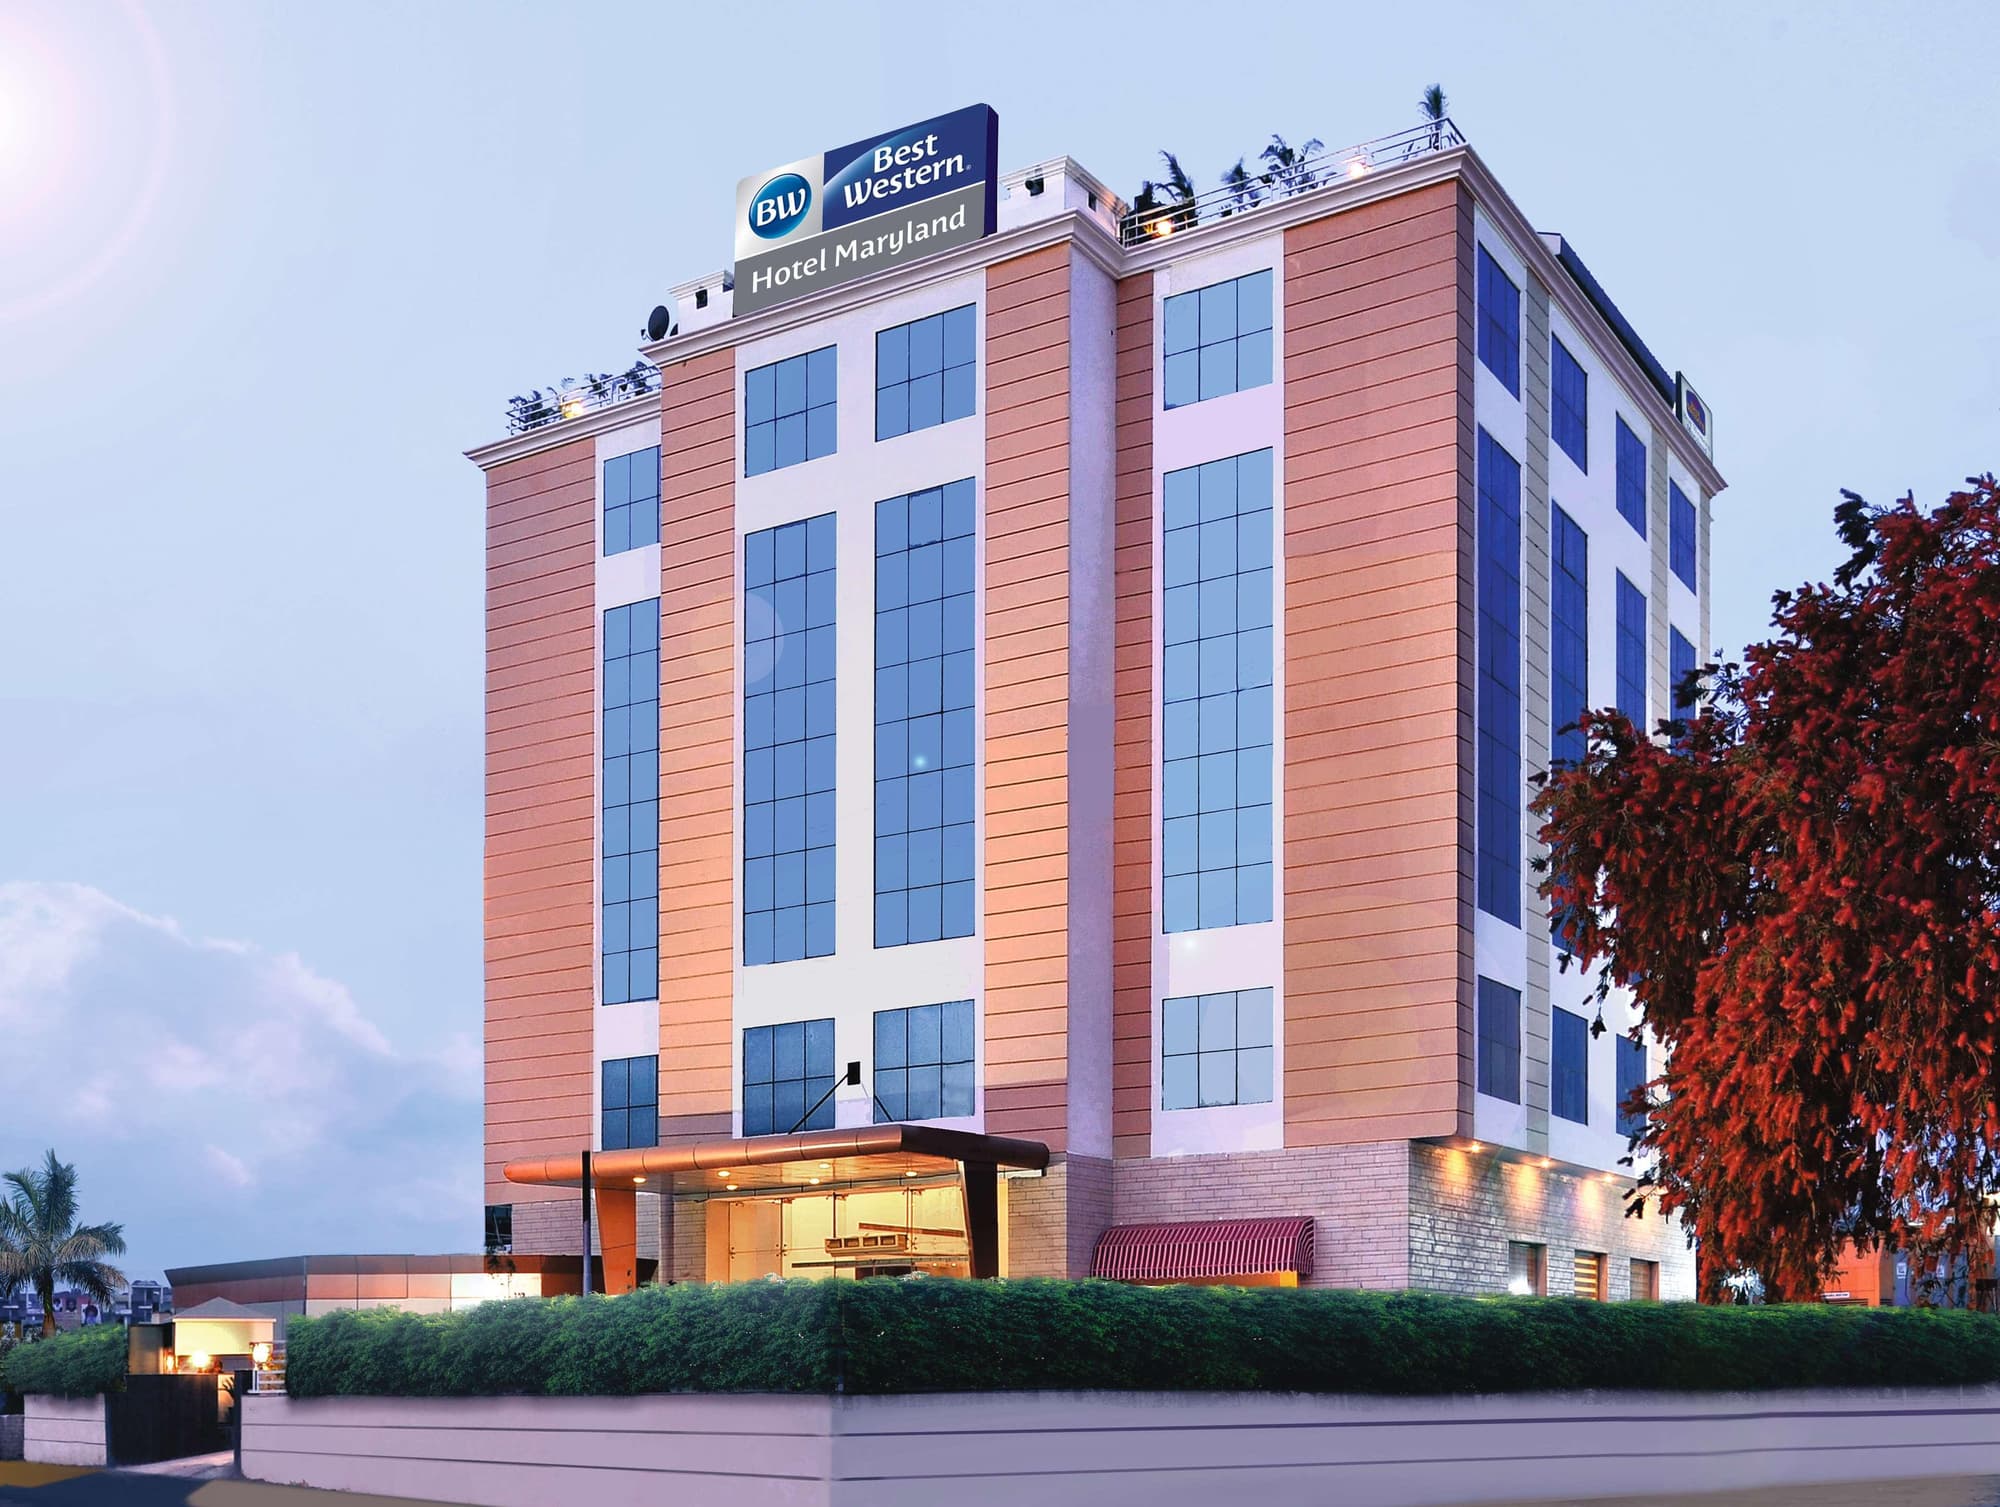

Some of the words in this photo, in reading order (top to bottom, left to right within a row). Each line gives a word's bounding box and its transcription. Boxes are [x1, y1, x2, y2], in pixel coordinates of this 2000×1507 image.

[874, 134, 938, 173] Best
[843, 153, 964, 209] Western
[756, 188, 806, 227] BW
[752, 248, 826, 294] Hotel
[835, 204, 966, 268] Maryland
